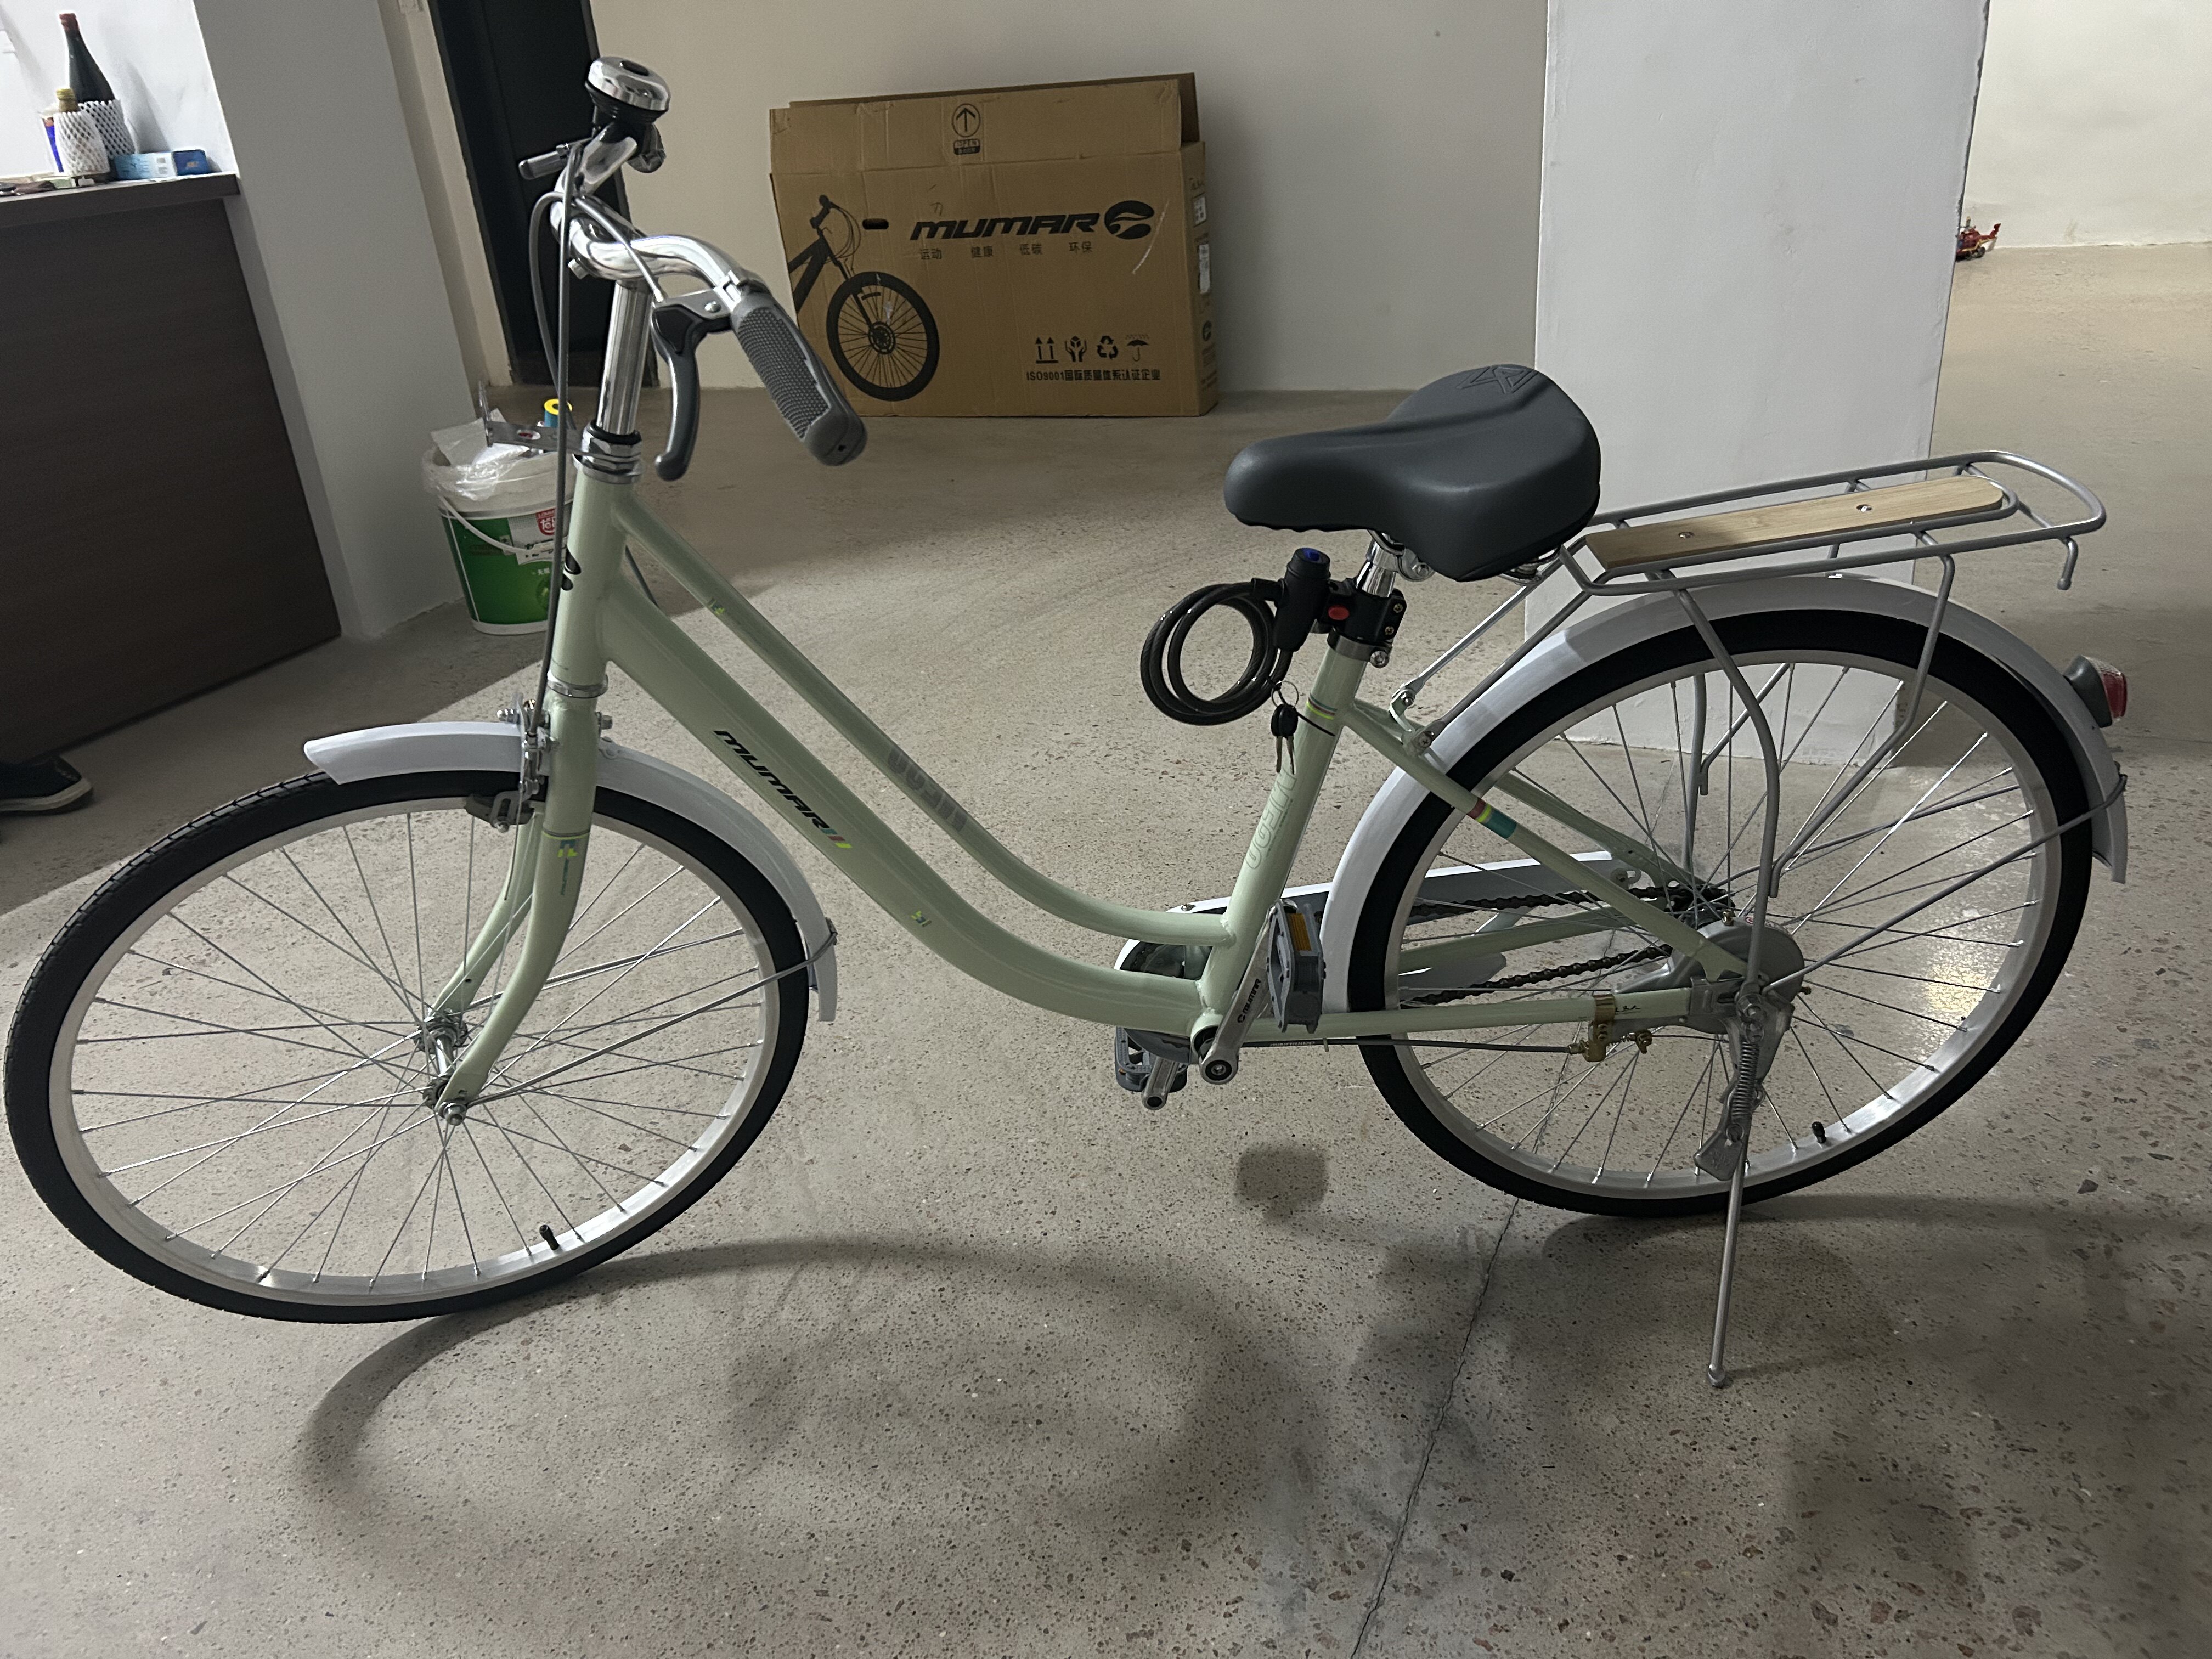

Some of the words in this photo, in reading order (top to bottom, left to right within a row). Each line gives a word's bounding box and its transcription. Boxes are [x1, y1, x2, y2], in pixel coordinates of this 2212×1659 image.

[910, 213, 1100, 240] MUMAR
[921, 248, 943, 260] 运动
[971, 245, 994, 258] 健康
[1019, 243, 1042, 256] 低碳
[1069, 241, 1092, 253] 环保
[713, 731, 830, 828] MUMAR
